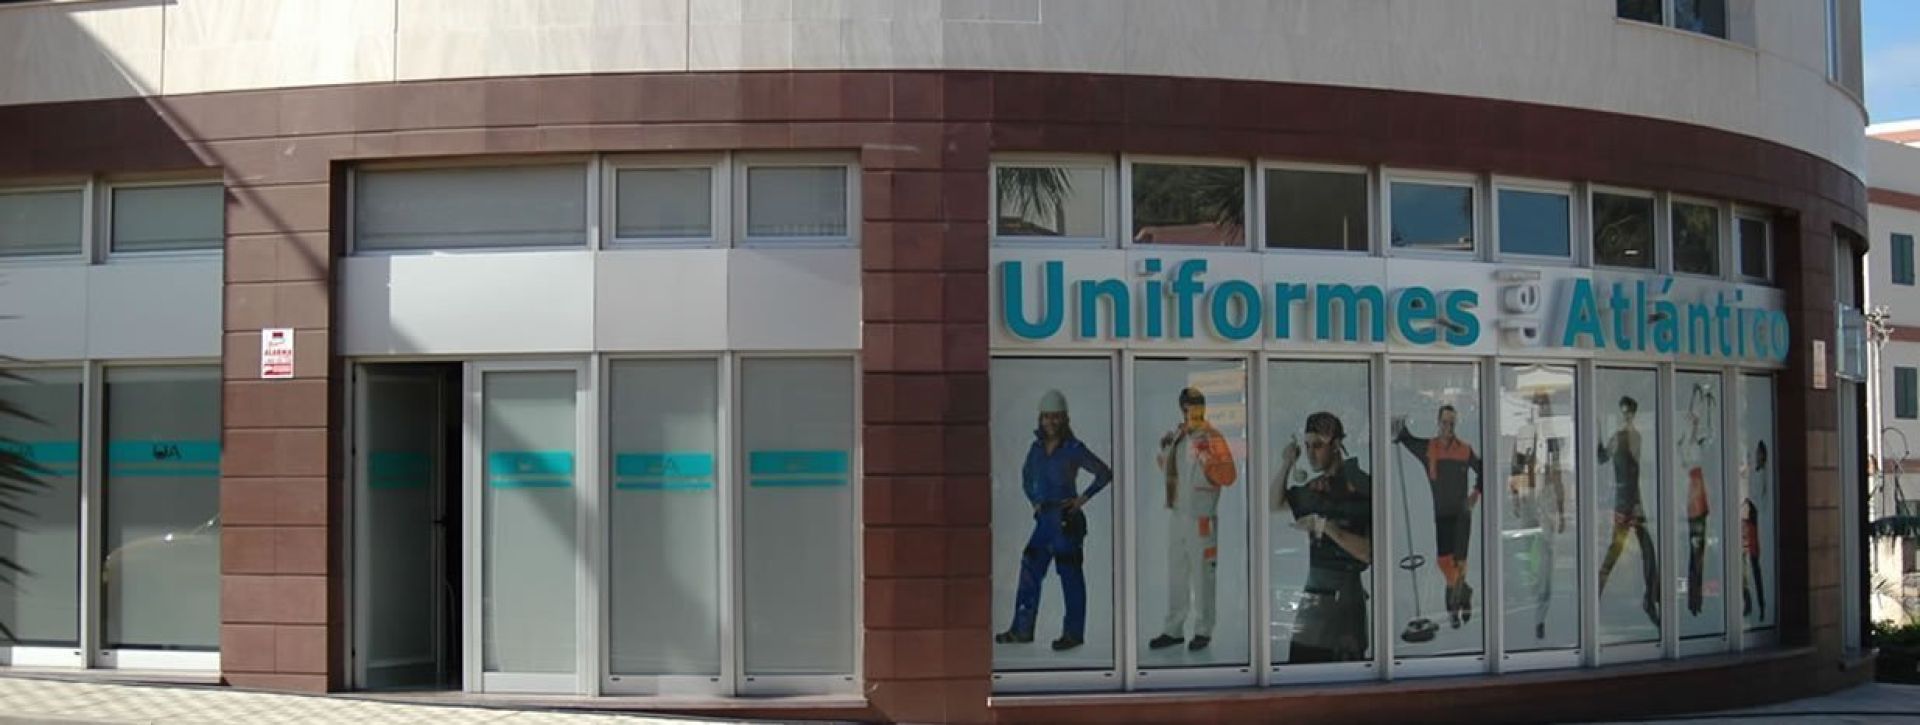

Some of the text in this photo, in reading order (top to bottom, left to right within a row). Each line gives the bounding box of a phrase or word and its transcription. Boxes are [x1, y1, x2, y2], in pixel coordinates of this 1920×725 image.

[1003, 258, 1790, 363] Uniformes del Atlántico
